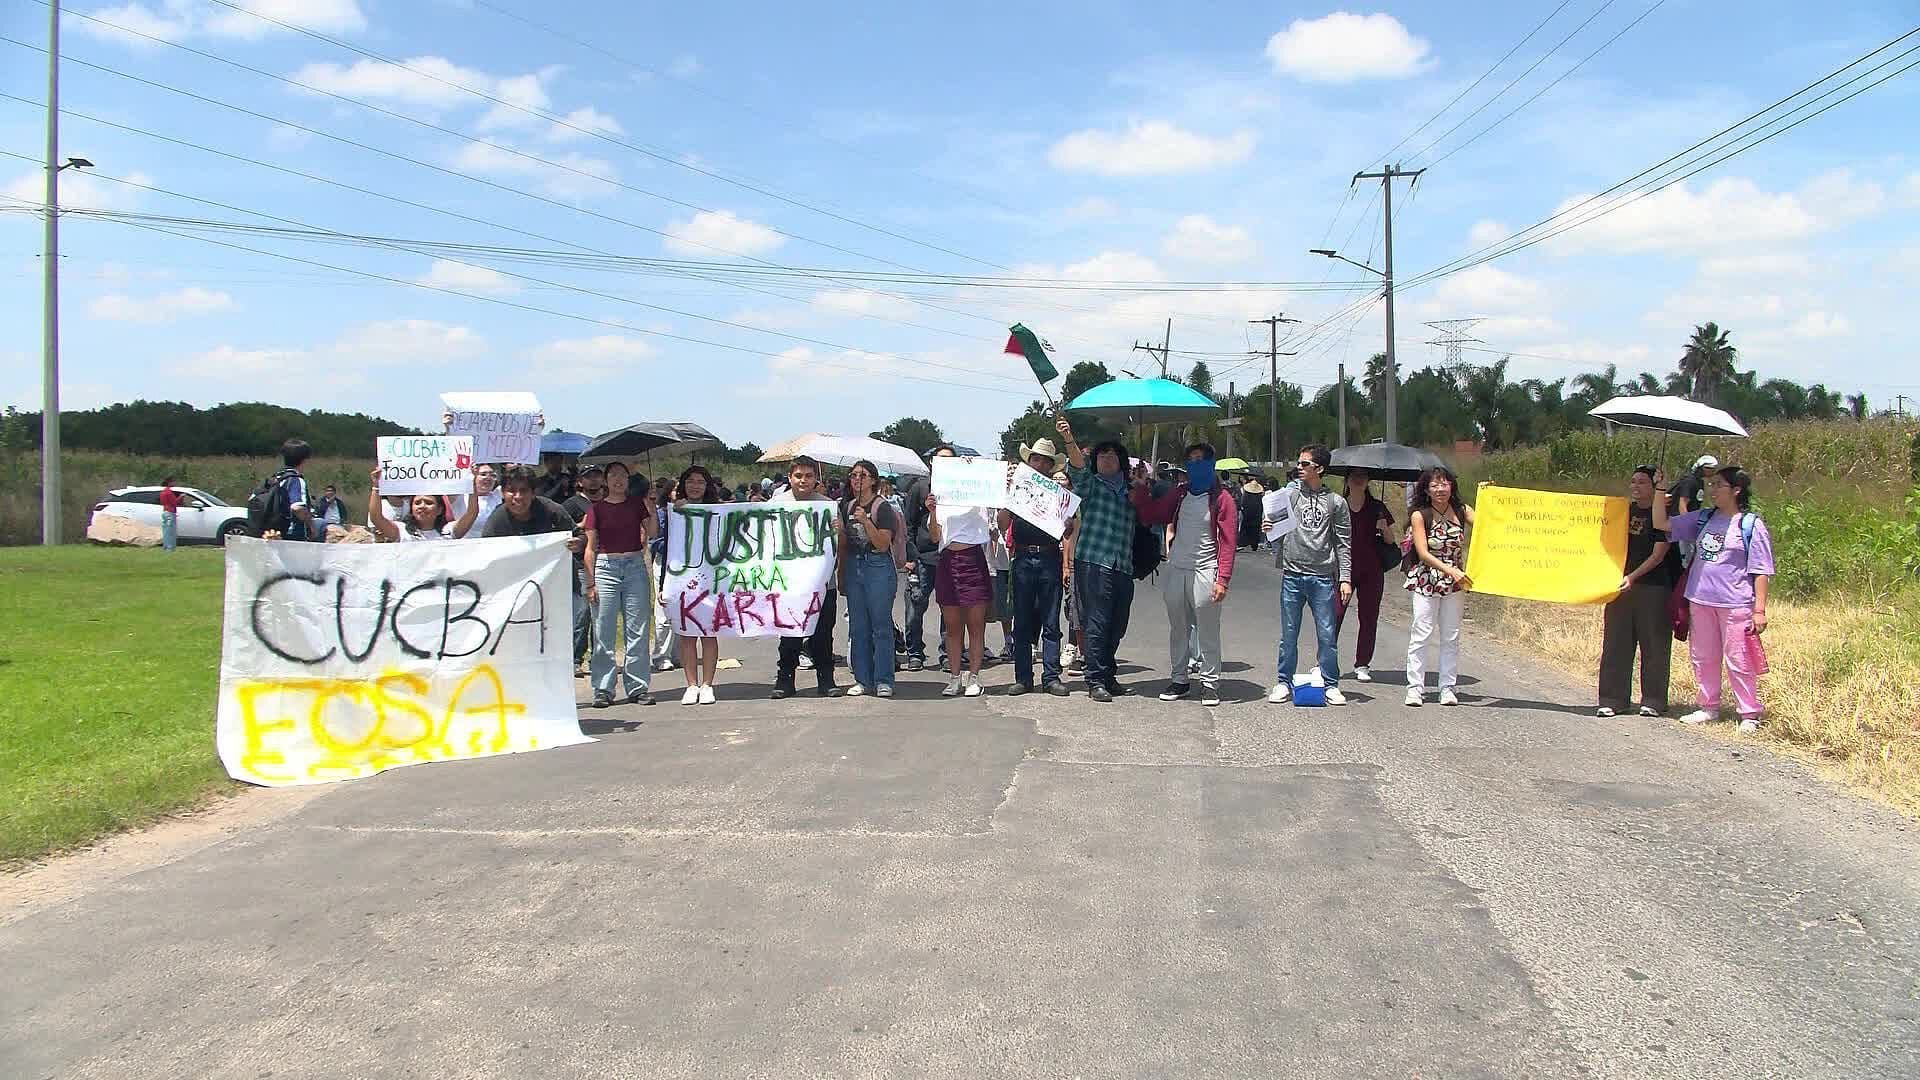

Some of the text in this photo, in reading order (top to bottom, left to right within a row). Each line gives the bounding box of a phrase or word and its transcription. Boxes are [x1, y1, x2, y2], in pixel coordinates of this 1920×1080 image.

[382, 460, 416, 480] Fosa
[393, 438, 440, 458] CUCBA
[667, 507, 838, 576] JUSTICIA
[713, 565, 788, 595] PARA
[251, 572, 546, 665] CUCBA
[679, 589, 822, 636] KARLA
[235, 663, 527, 757] FOSA
